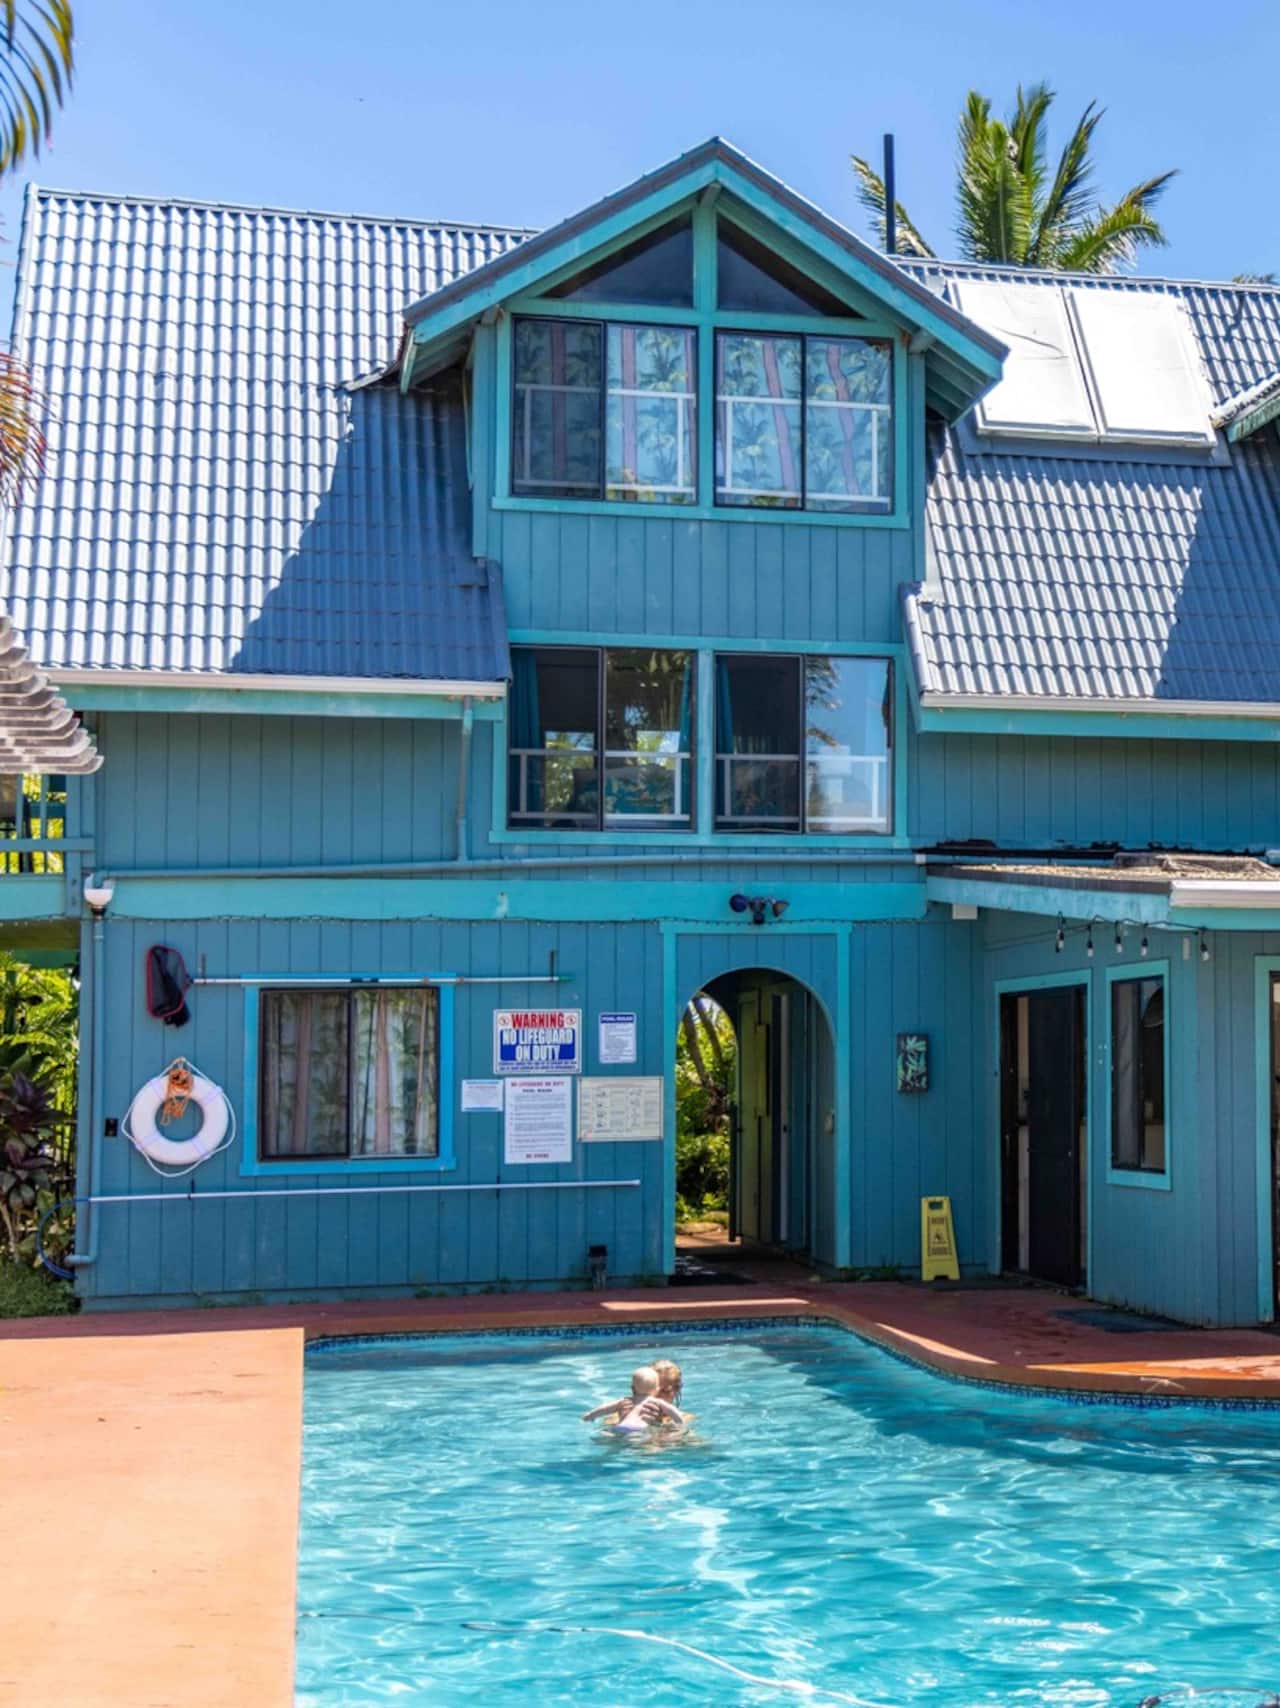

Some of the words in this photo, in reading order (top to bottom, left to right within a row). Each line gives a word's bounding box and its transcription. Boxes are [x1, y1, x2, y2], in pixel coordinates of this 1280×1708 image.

[511, 1012, 565, 1028] WARNING
[503, 1029, 517, 1045] NO
[520, 1028, 573, 1045] LIFEGUARD
[515, 1045, 530, 1061] ON
[533, 1045, 560, 1060] DUTY
